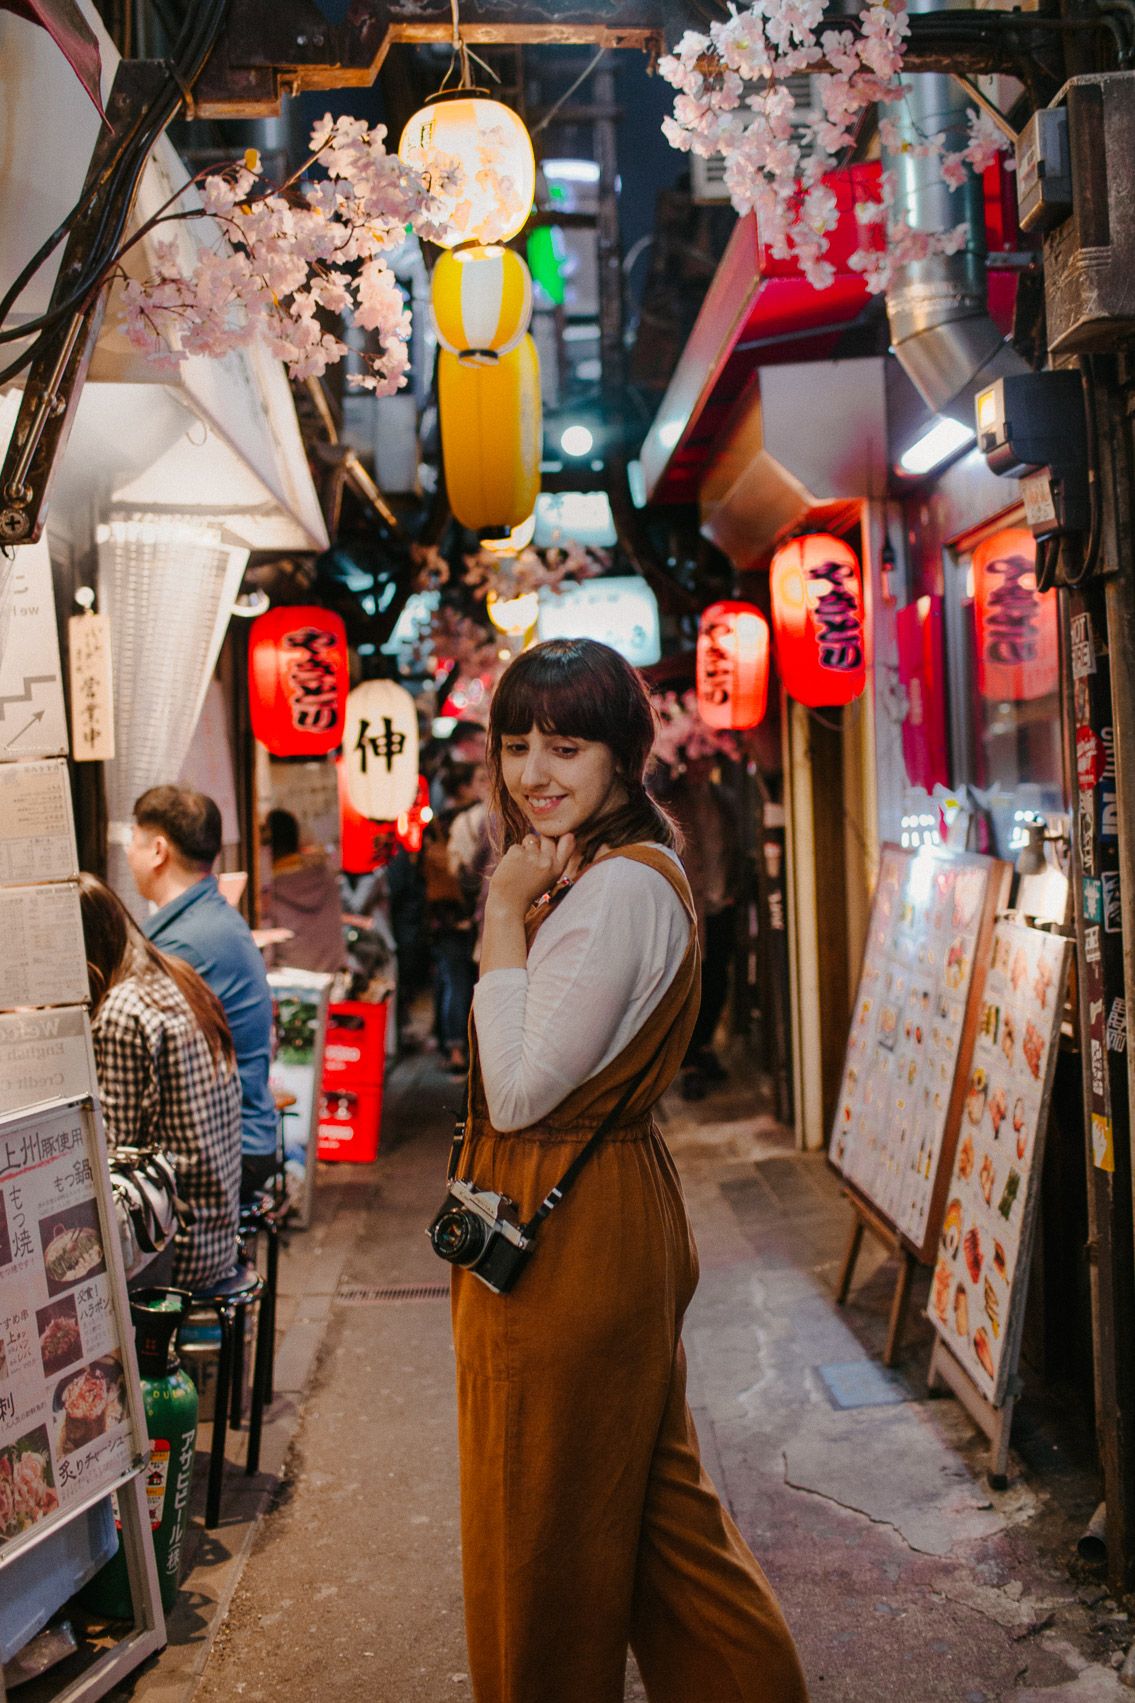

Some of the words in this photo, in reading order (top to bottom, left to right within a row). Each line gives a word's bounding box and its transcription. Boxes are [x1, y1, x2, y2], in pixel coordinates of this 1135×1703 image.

[0, 1128, 83, 1174] 上州豚使用
[54, 1159, 94, 1193] もつ鍋
[9, 1184, 35, 1258] もつ焼
[0, 1309, 29, 1330] すめ串
[166, 1429, 196, 1575] アサヒビール(株)
